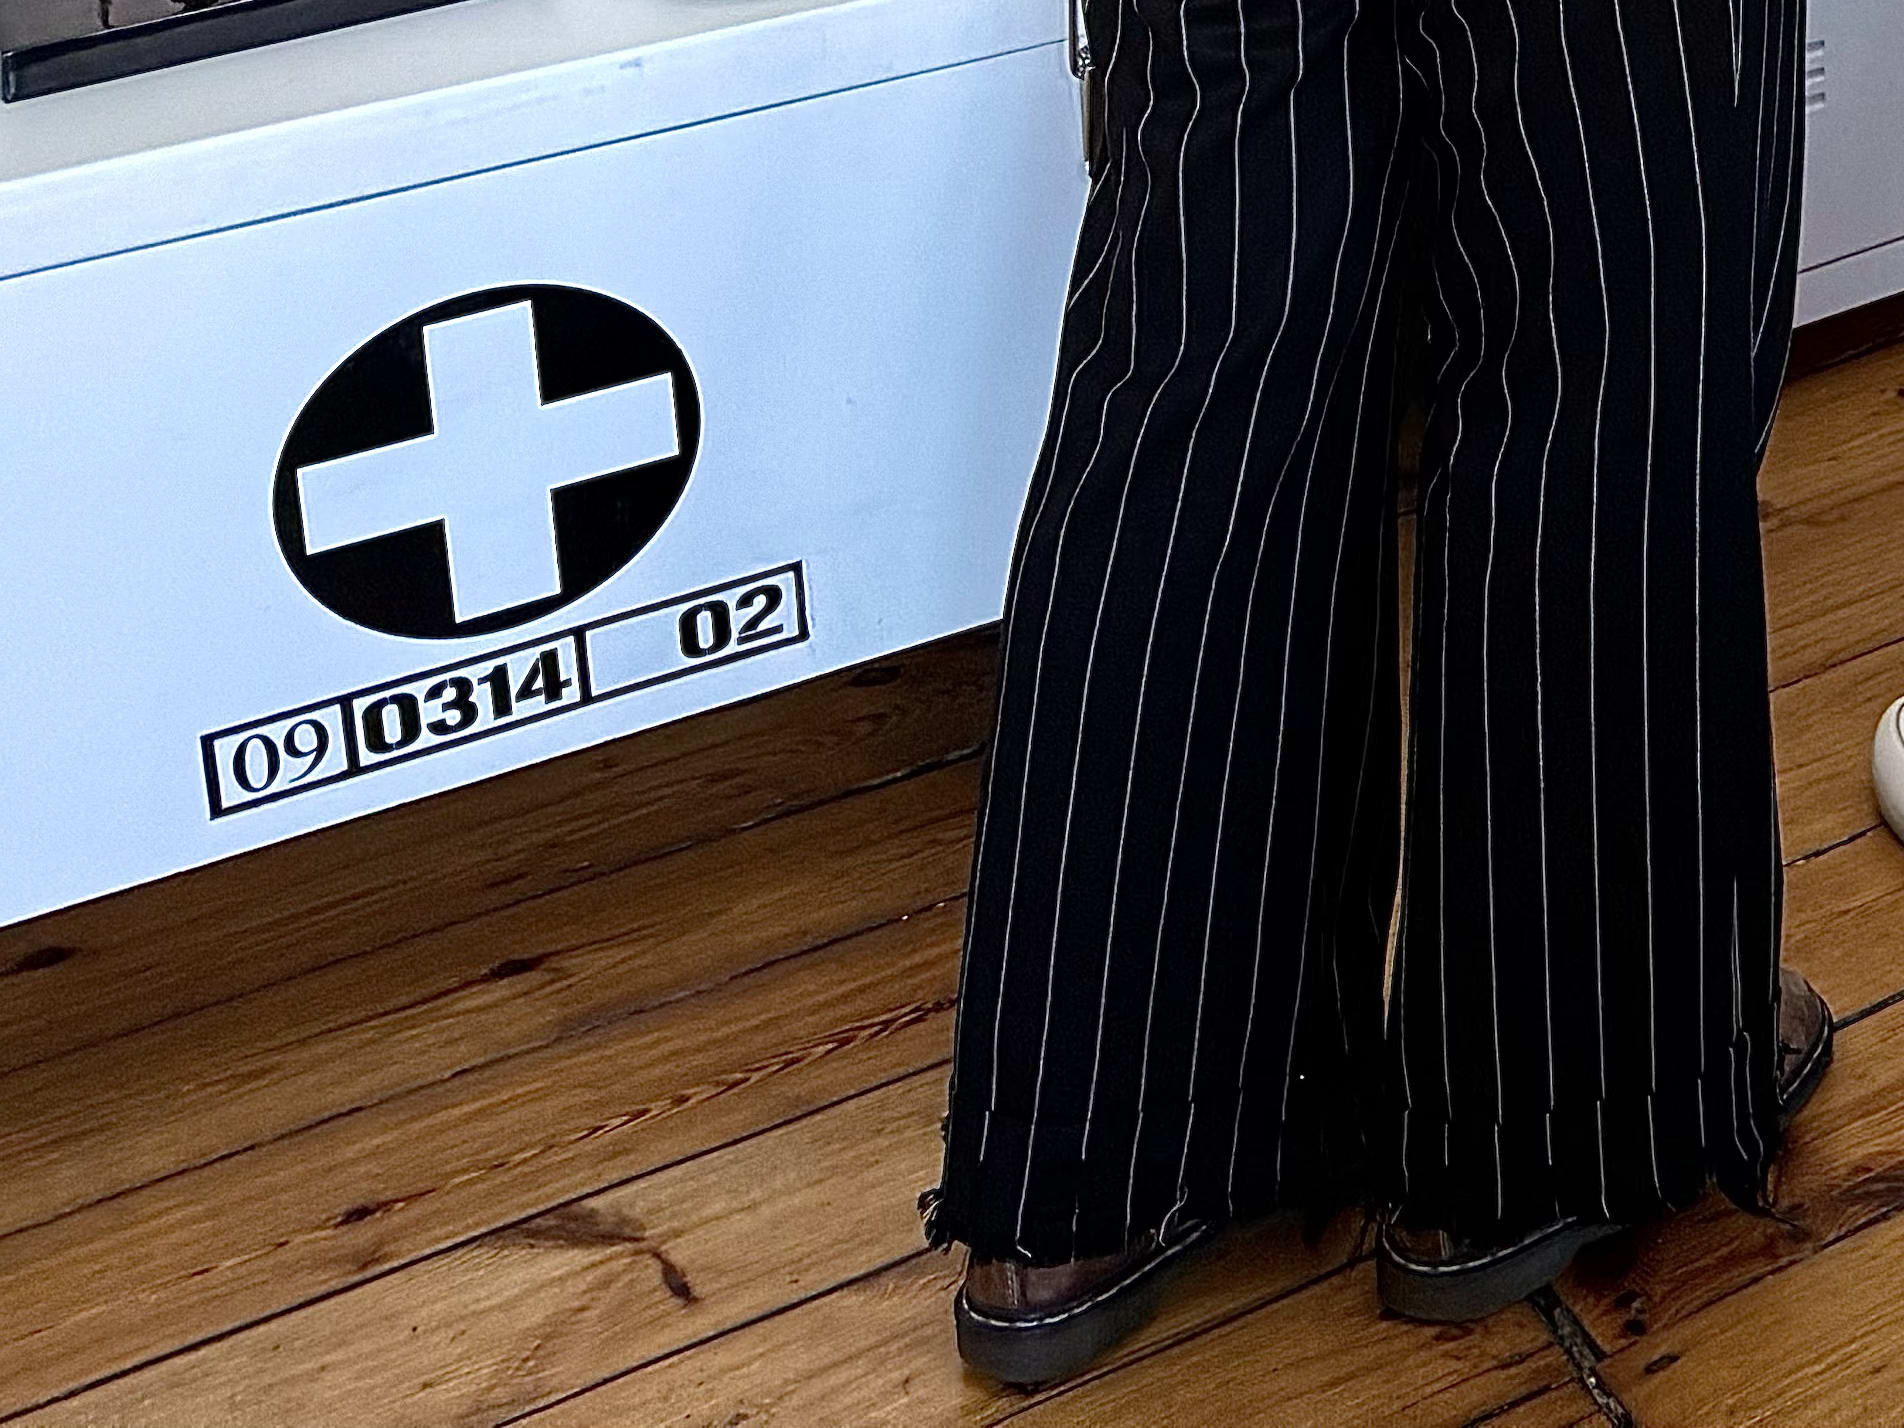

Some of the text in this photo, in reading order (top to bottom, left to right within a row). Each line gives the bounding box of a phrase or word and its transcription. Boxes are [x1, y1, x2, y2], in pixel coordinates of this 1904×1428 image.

[232, 583, 784, 794] 09 0314 02
